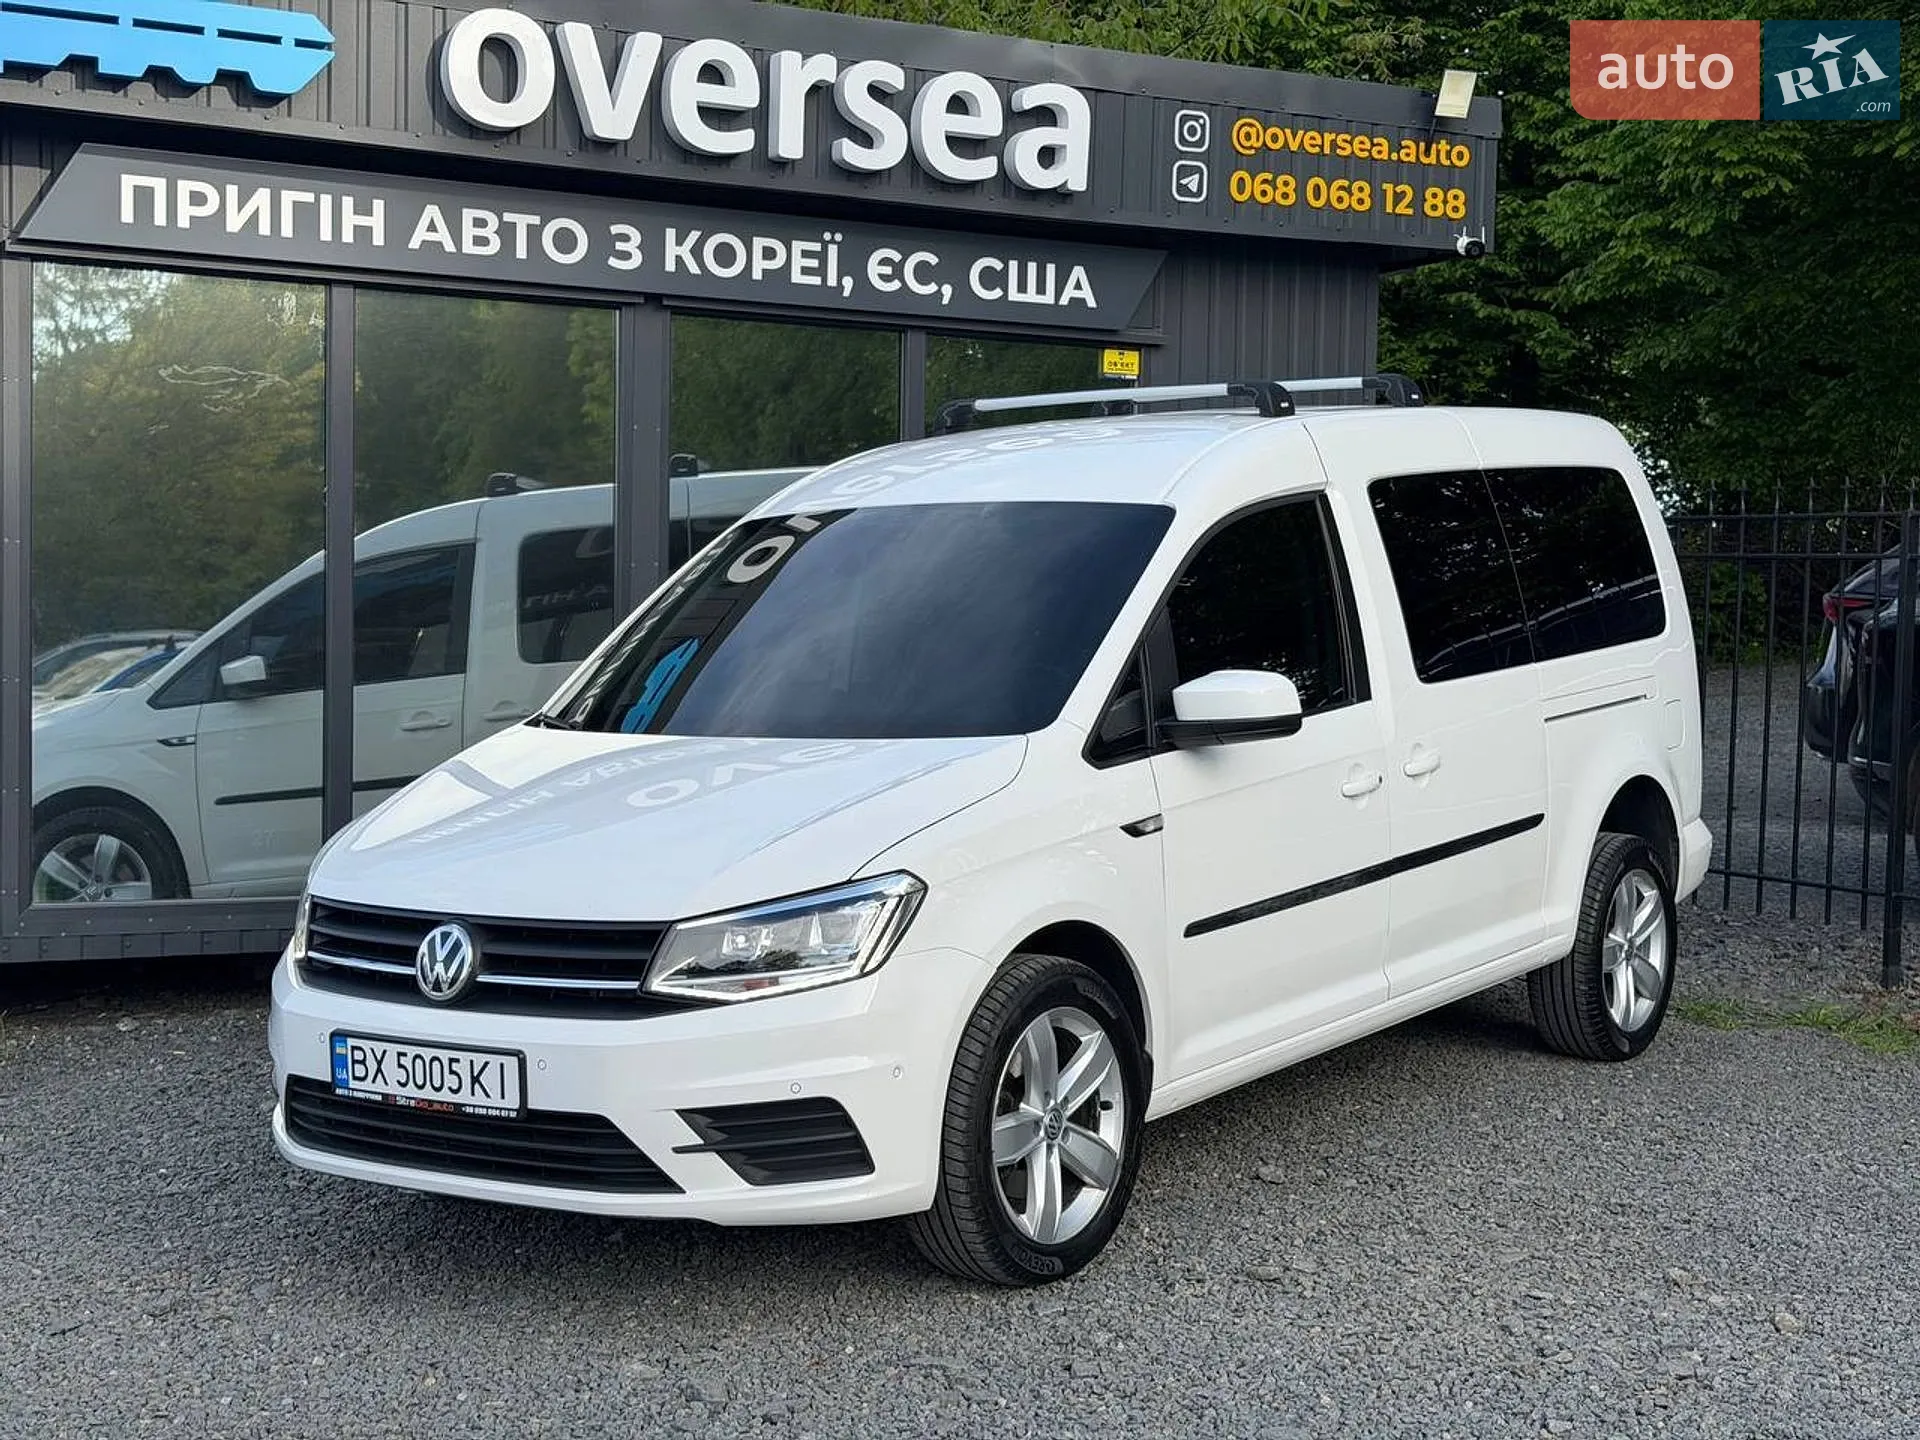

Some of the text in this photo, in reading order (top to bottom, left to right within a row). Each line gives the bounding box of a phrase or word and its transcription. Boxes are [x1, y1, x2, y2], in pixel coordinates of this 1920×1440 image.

[440, 7, 1092, 193] oversea
[1231, 116, 1471, 168] @oversea.auto
[1229, 170, 1467, 220] 068 068 12 88
[119, 172, 387, 247] ПРИГІН
[407, 203, 590, 266] АВТО
[664, 227, 854, 298] КОРЕЇ,
[866, 247, 953, 305] ЄС,
[969, 256, 1098, 309] США
[335, 1045, 506, 1100] UA BX 5005 KI
